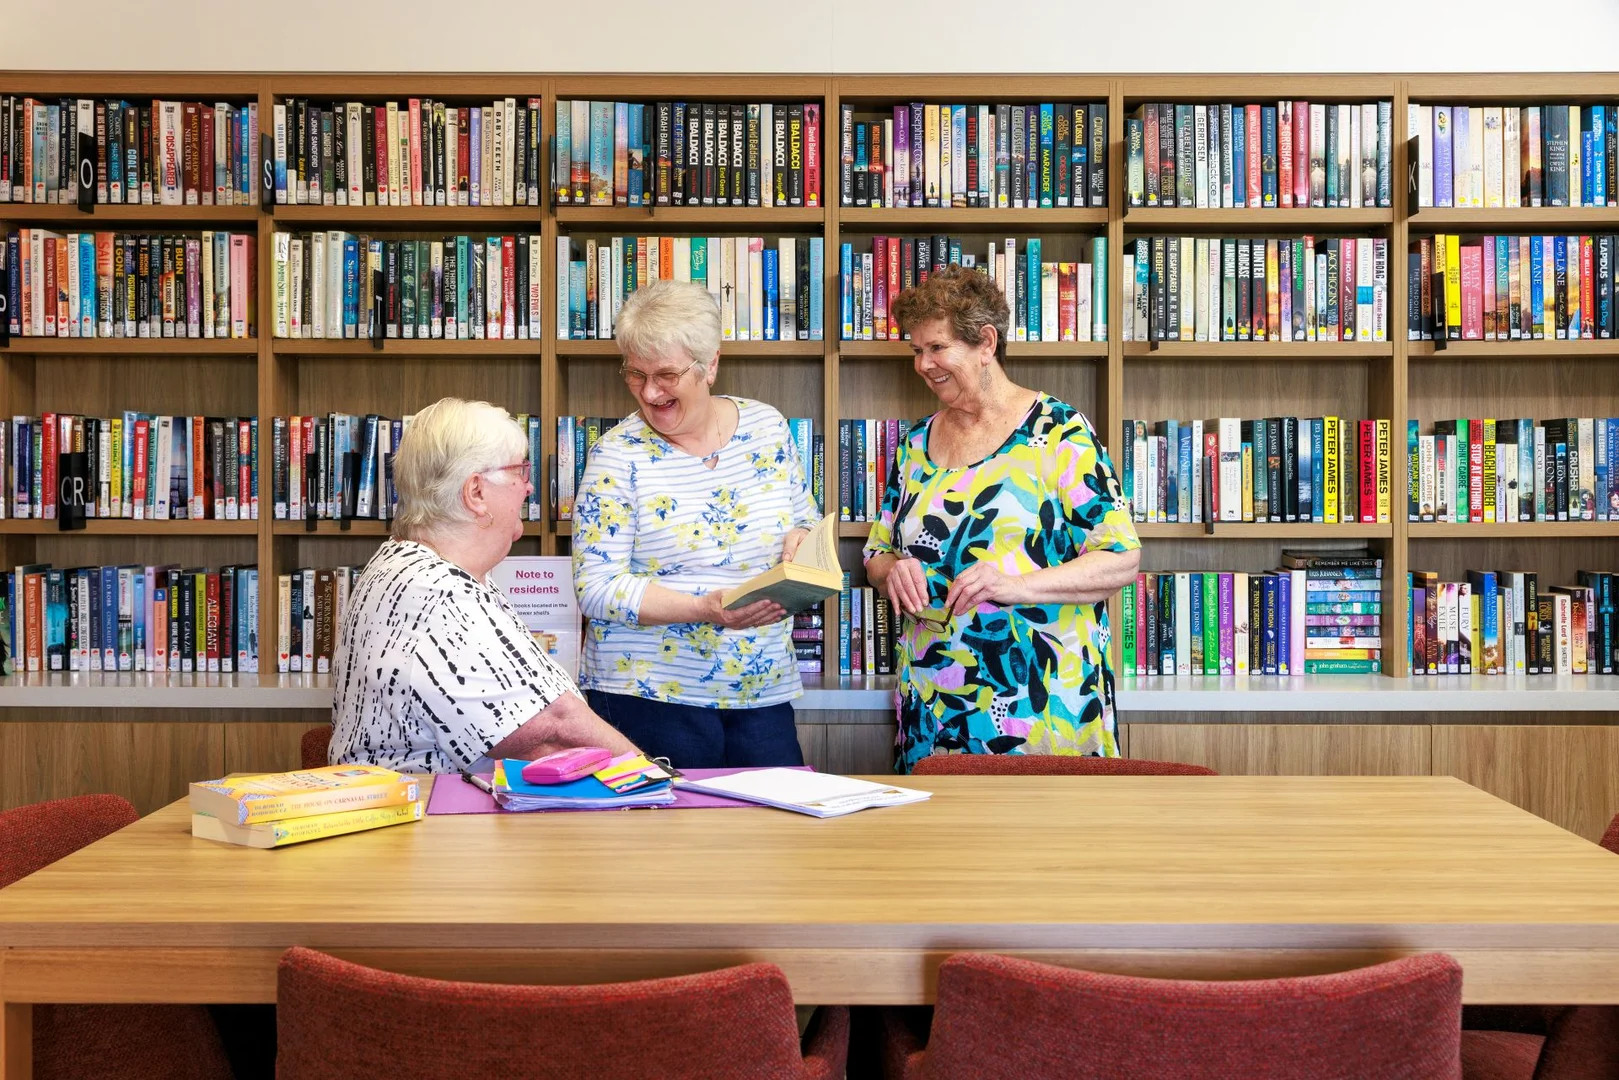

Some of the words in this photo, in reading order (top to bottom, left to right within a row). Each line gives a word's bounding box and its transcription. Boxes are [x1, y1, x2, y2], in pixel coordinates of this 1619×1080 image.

[660, 107, 668, 132] SARAH
[749, 120, 758, 138] David
[660, 133, 668, 159] BAILEY
[690, 122, 699, 165] BALDACCI
[705, 123, 713, 166] BALDACCI
[718, 123, 727, 166] BALDACCI
[733, 123, 742, 167] BALDACCI
[749, 139, 758, 170] Baldacci
[776, 123, 785, 167] BALDACCI
[791, 123, 800, 169] BALDACCI
[1197, 118, 1205, 162] GERRITSEN
[1282, 131, 1291, 170] GRISHAM
[81, 158, 93, 189] O
[166, 136, 175, 185] DISAPPEARED
[263, 159, 273, 190] S
[1075, 166, 1083, 182] POLAR
[1075, 184, 1083, 198] SHIFT
[1409, 161, 1417, 194] K
[81, 246, 90, 263] JAMES
[98, 242, 110, 269] SAIL
[175, 248, 183, 274] BURN
[1224, 244, 1235, 278] HANGMAN
[1238, 245, 1249, 279] HEADCASE
[1254, 245, 1264, 279] HUNTER
[1328, 250, 1337, 271] JACK
[1375, 243, 1385, 259] TAMI
[1600, 243, 1608, 279] LAPIDUS
[82, 264, 90, 296] PATTERSON
[100, 275, 109, 291] JAMES
[1375, 261, 1385, 279] HOAG
[1462, 256, 1470, 288] LAMB
[1471, 253, 1479, 291] WALLY
[1557, 258, 1565, 286] LANE
[531, 283, 539, 294] TWO
[1328, 272, 1337, 306] HIGGINS
[100, 292, 109, 320] PATTERSON
[531, 295, 539, 316] EVILS
[1600, 299, 1608, 311] Top
[1600, 311, 1608, 326] Dog
[1328, 420, 1336, 455] PETER
[1364, 424, 1372, 458] PETER
[1380, 422, 1388, 456] PETER
[1471, 444, 1481, 464] STOP
[1471, 465, 1481, 474] AT
[1485, 445, 1495, 471] BEACH
[1546, 455, 1554, 483] LEON
[1328, 457, 1336, 494] JAMES
[1364, 461, 1372, 496] JAMES
[1380, 459, 1388, 494] JAMES
[1569, 451, 1578, 491] CRUSHER
[61, 476, 84, 506] CR
[1471, 476, 1481, 510] NOTHING
[1485, 473, 1495, 507] MURDER
[509, 585, 560, 594] residents
[516, 570, 541, 579] Note
[543, 571, 554, 579] to
[1208, 578, 1216, 606] Rachael
[1222, 578, 1230, 604] Rachael
[208, 598, 217, 652] ALLEGIANT
[323, 624, 330, 634] OF
[877, 599, 888, 634] FORSYTH
[1208, 606, 1216, 628] Johns
[1222, 604, 1230, 625] Johns
[1461, 607, 1469, 631] FURY
[1125, 614, 1133, 649] JAMES
[334, 796, 365, 805] CARNAVAL
